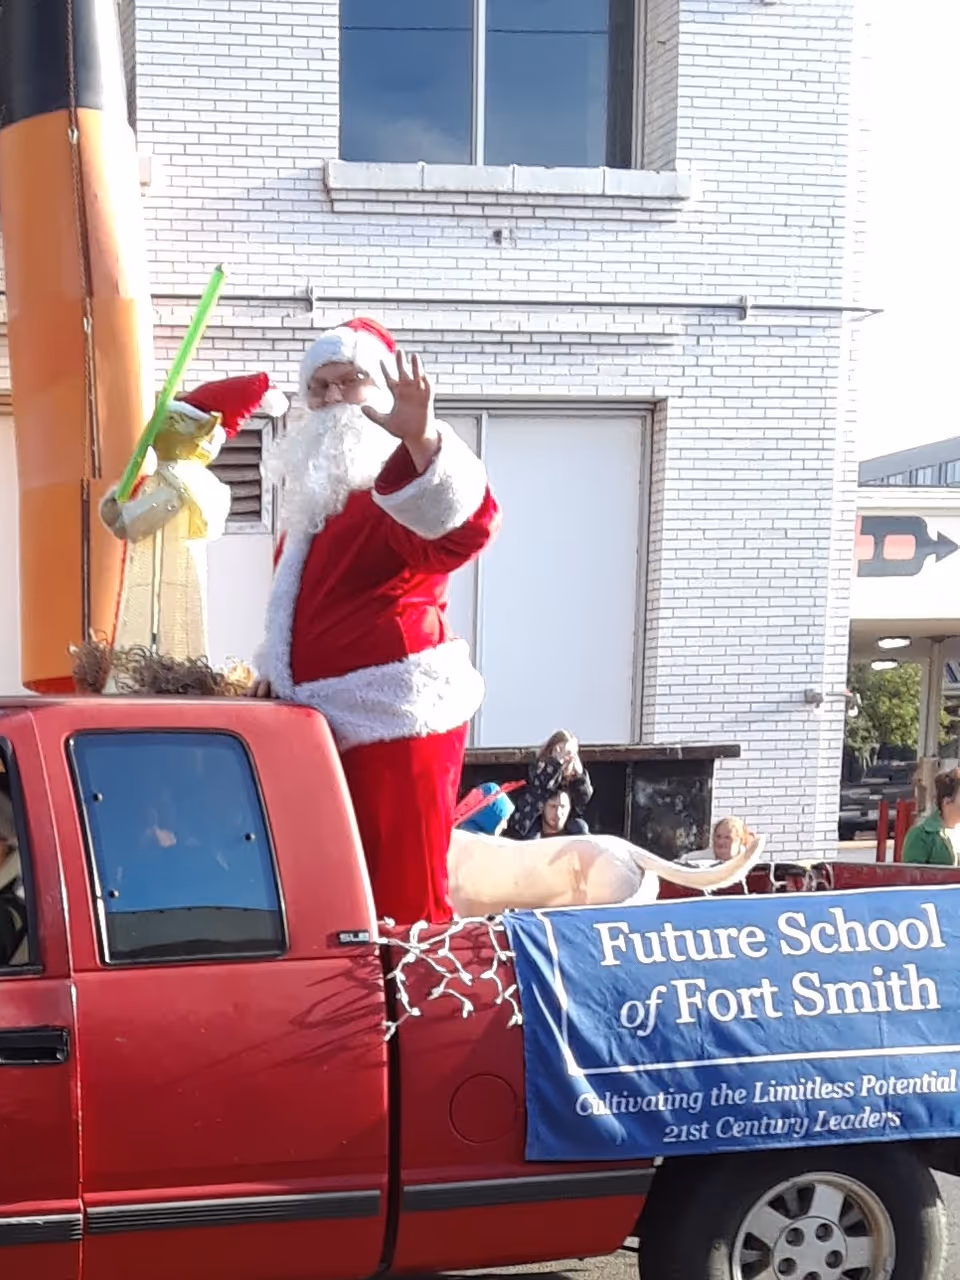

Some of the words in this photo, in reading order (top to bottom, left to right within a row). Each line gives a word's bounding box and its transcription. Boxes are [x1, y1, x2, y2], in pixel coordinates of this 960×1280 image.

[593, 921, 768, 966] Future
[777, 903, 946, 955] School
[619, 986, 667, 1037] of
[671, 978, 783, 1024] Fort
[791, 963, 941, 1016] Smith
[575, 1087, 704, 1116] Cultivating
[710, 1082, 748, 1106] the
[754, 1076, 855, 1104] Limitless
[860, 1069, 957, 1097] Potential
[662, 1120, 711, 1142] 21st
[715, 1116, 809, 1139] Century
[814, 1106, 903, 1132] Leaders
